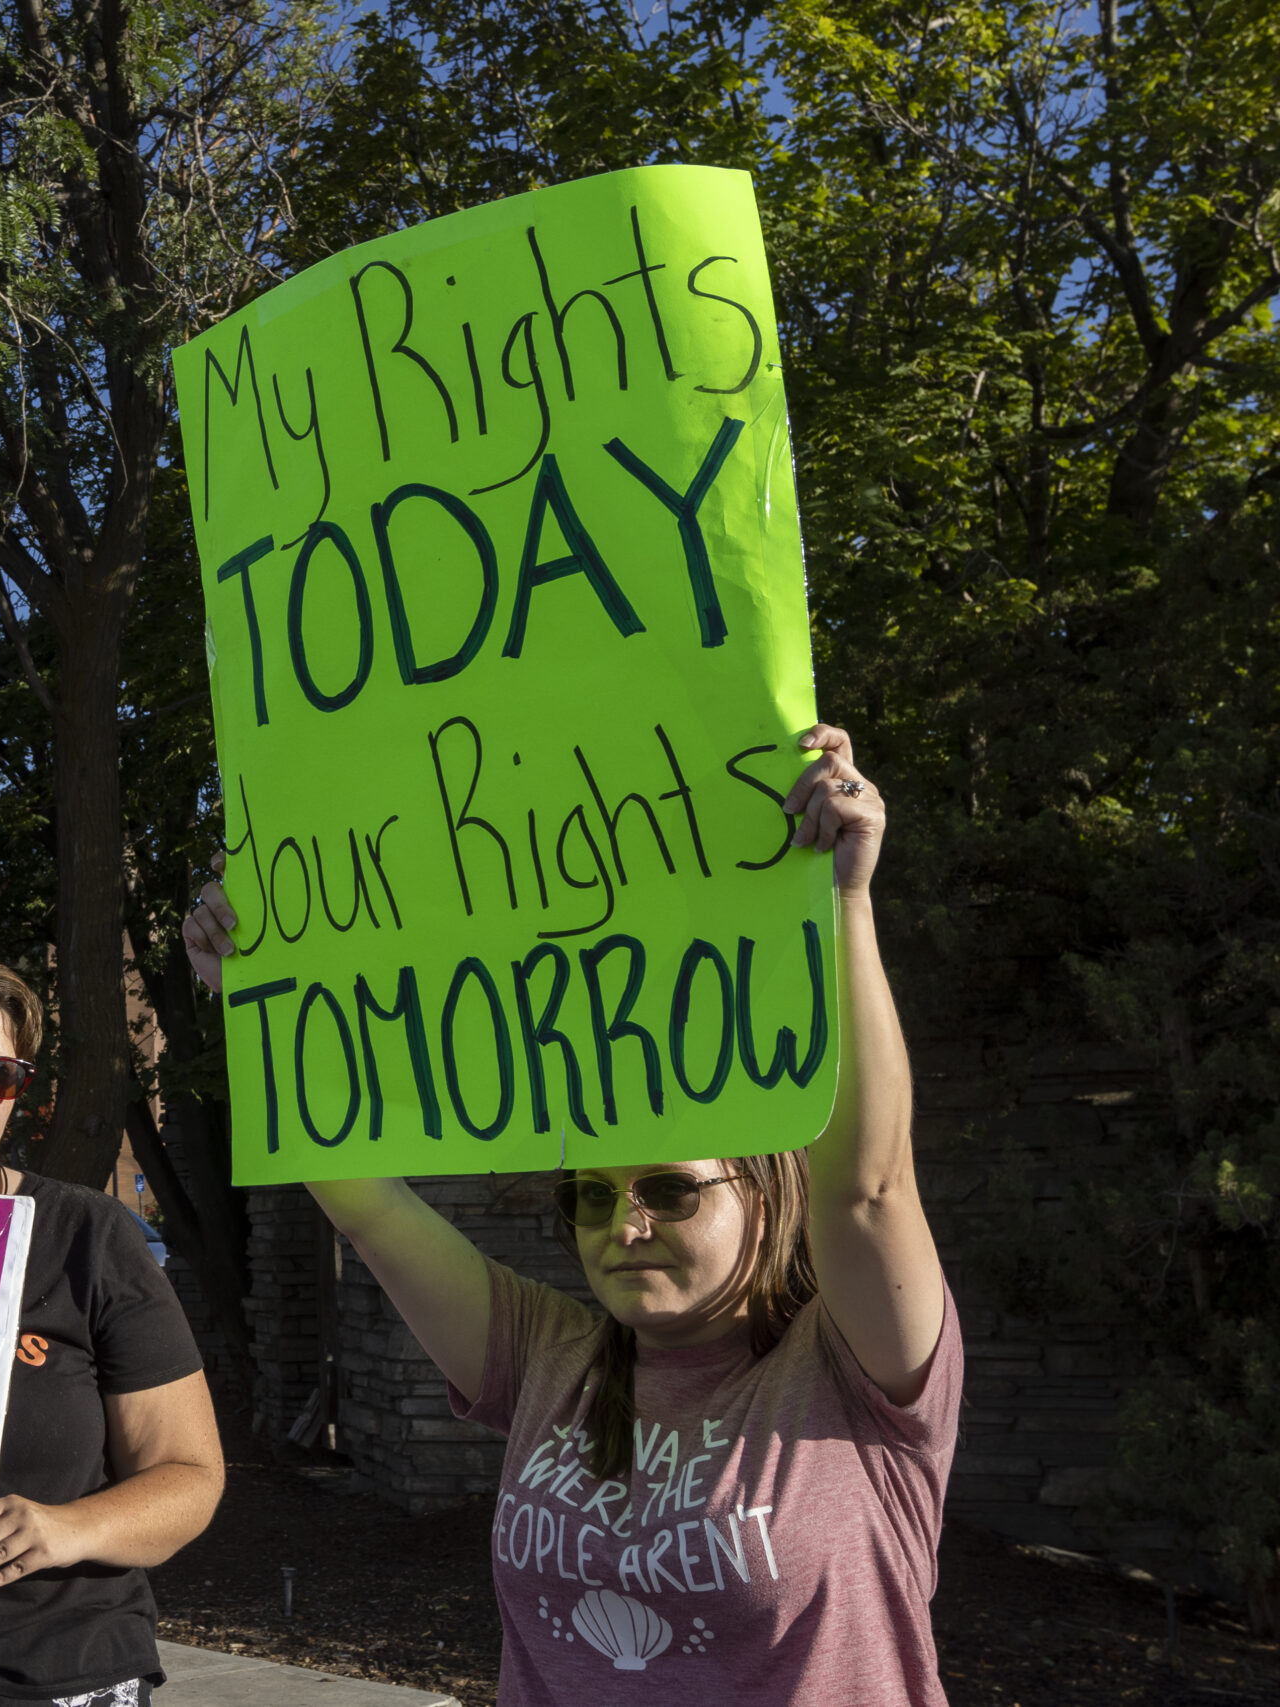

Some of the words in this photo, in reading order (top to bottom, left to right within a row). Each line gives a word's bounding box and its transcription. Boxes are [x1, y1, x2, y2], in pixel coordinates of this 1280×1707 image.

[205, 324, 330, 551] My
[348, 205, 763, 496] Rights
[217, 416, 745, 727] TODAY
[222, 773, 399, 957] Your
[427, 715, 796, 939] Rights
[228, 919, 829, 1154] TOMORROW
[492, 1488, 606, 1587] EOPLE
[641, 1454, 712, 1528] THE
